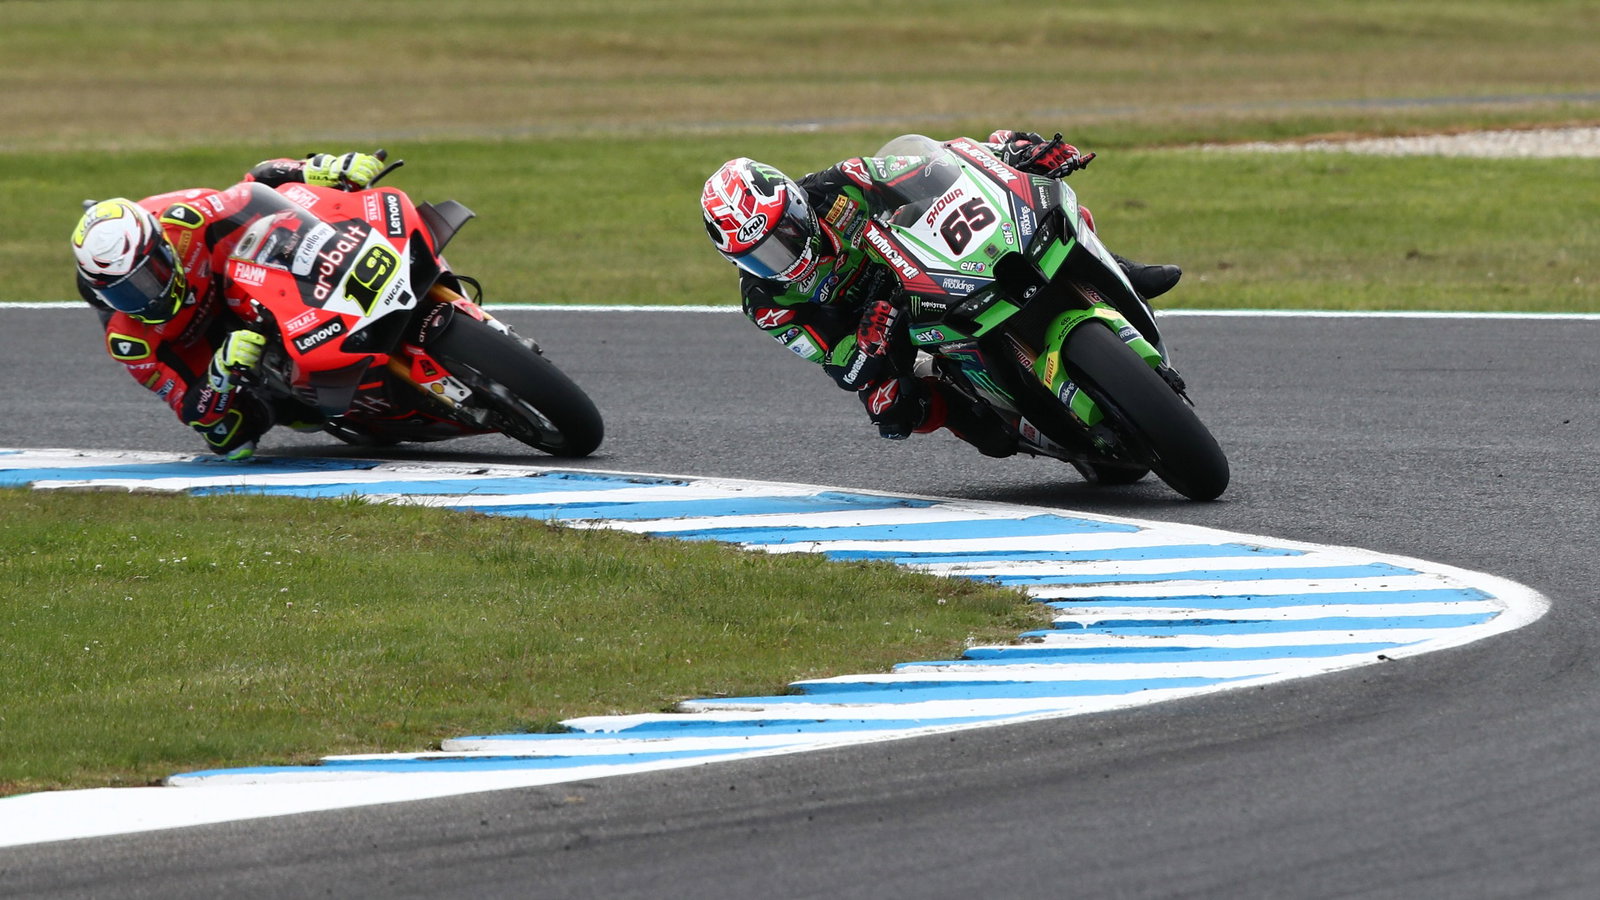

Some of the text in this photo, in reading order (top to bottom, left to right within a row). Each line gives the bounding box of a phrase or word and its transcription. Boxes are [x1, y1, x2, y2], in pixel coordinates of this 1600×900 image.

[387, 195, 402, 235] Lenovo
[926, 188, 964, 228] SHOWA
[742, 215, 764, 241] Arai
[940, 197, 997, 256] 65
[1004, 231, 1014, 245] elf
[303, 234, 320, 256] riello
[235, 262, 267, 283] FIAMM
[313, 225, 367, 300] aruba.it
[960, 262, 977, 271] elf
[344, 245, 397, 316] 19
[384, 278, 404, 305] DUCATI
[820, 282, 830, 303] elf
[921, 301, 947, 310] MONSTER
[295, 322, 341, 350] Lenovo
